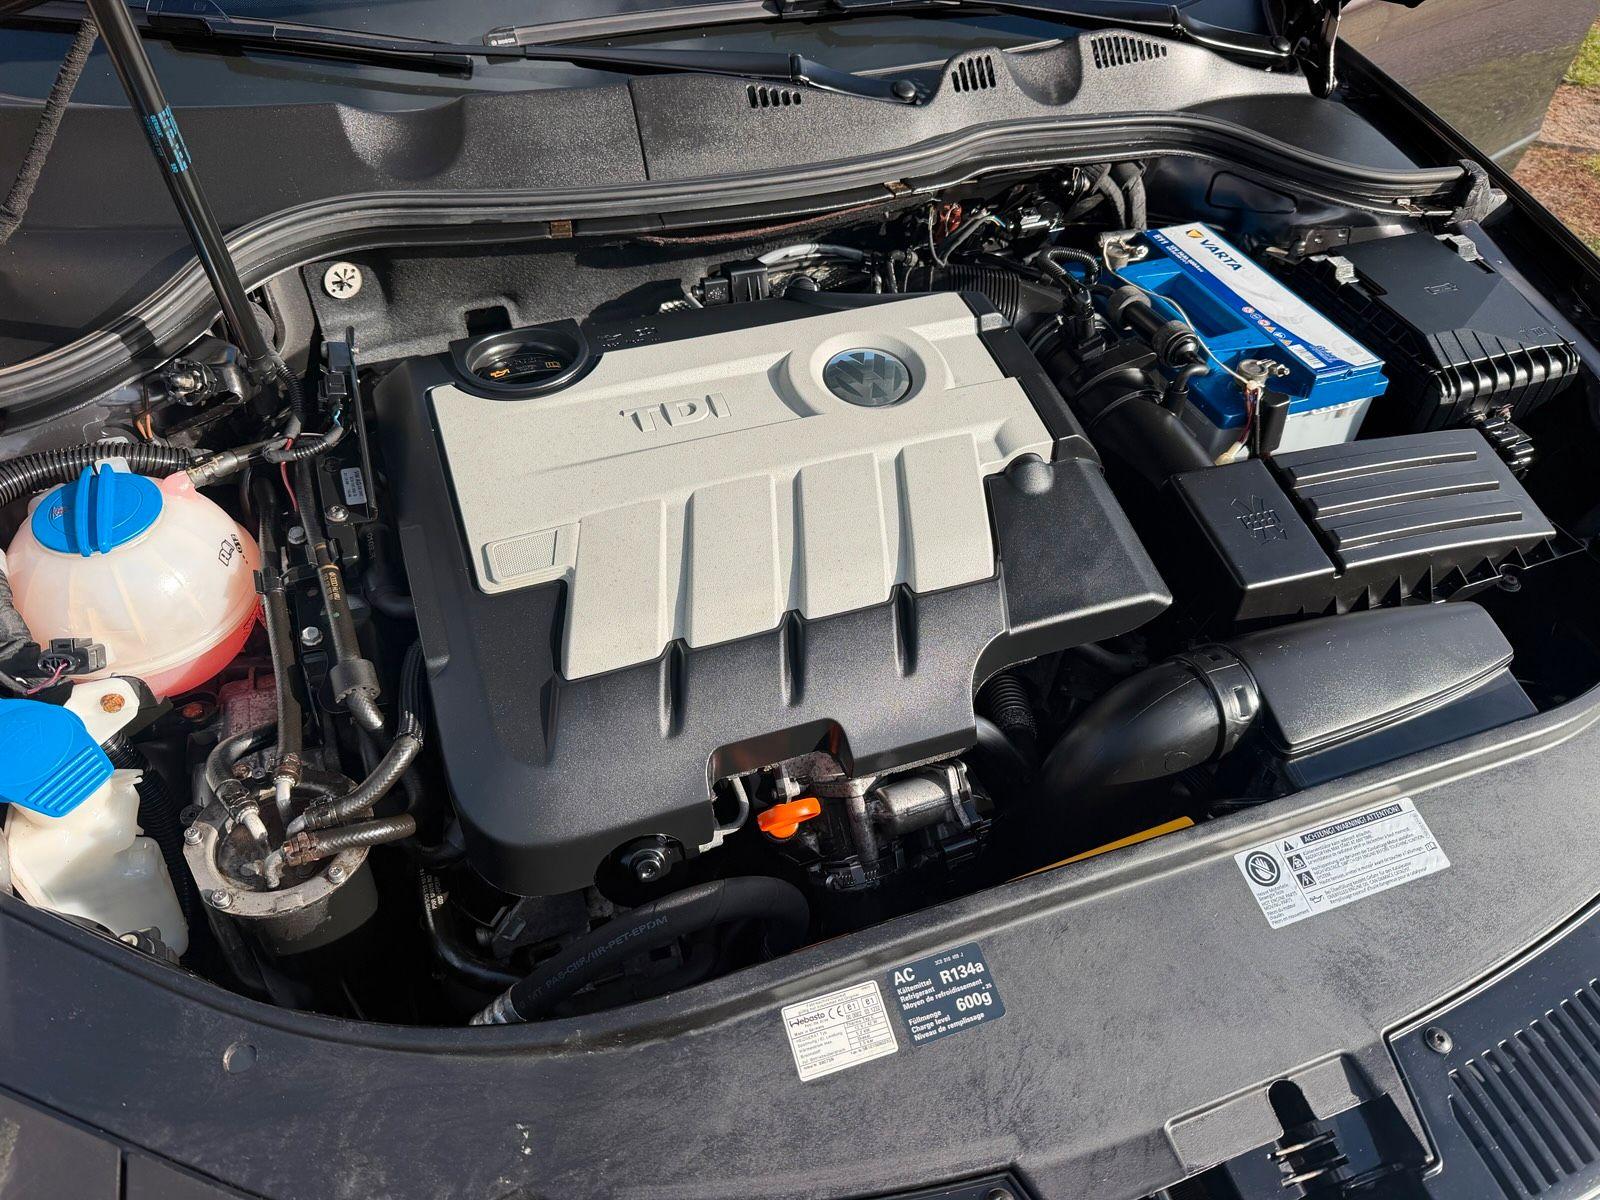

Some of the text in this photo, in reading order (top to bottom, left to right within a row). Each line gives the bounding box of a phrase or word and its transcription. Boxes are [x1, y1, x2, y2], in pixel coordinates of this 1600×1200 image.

[1200, 239, 1243, 271] VARTA
[618, 392, 732, 433] TDI
[1304, 805, 1400, 842] ACHTUNG! WARNING! ATTENTION!
[894, 967, 915, 985] AC
[940, 962, 984, 983] R134a
[897, 978, 931, 994] Kältemittel
[900, 986, 935, 1002] Refrigerant
[902, 999, 925, 1010] Moyen
[935, 979, 982, 998] refroidissement
[956, 992, 992, 1011] 600g
[789, 1012, 825, 1027] Webasto
[908, 1010, 941, 1025] Füllmenge
[911, 1014, 950, 1033] Charge level
[914, 1029, 937, 1040] Niveau
[947, 1012, 984, 1029] remplissage
